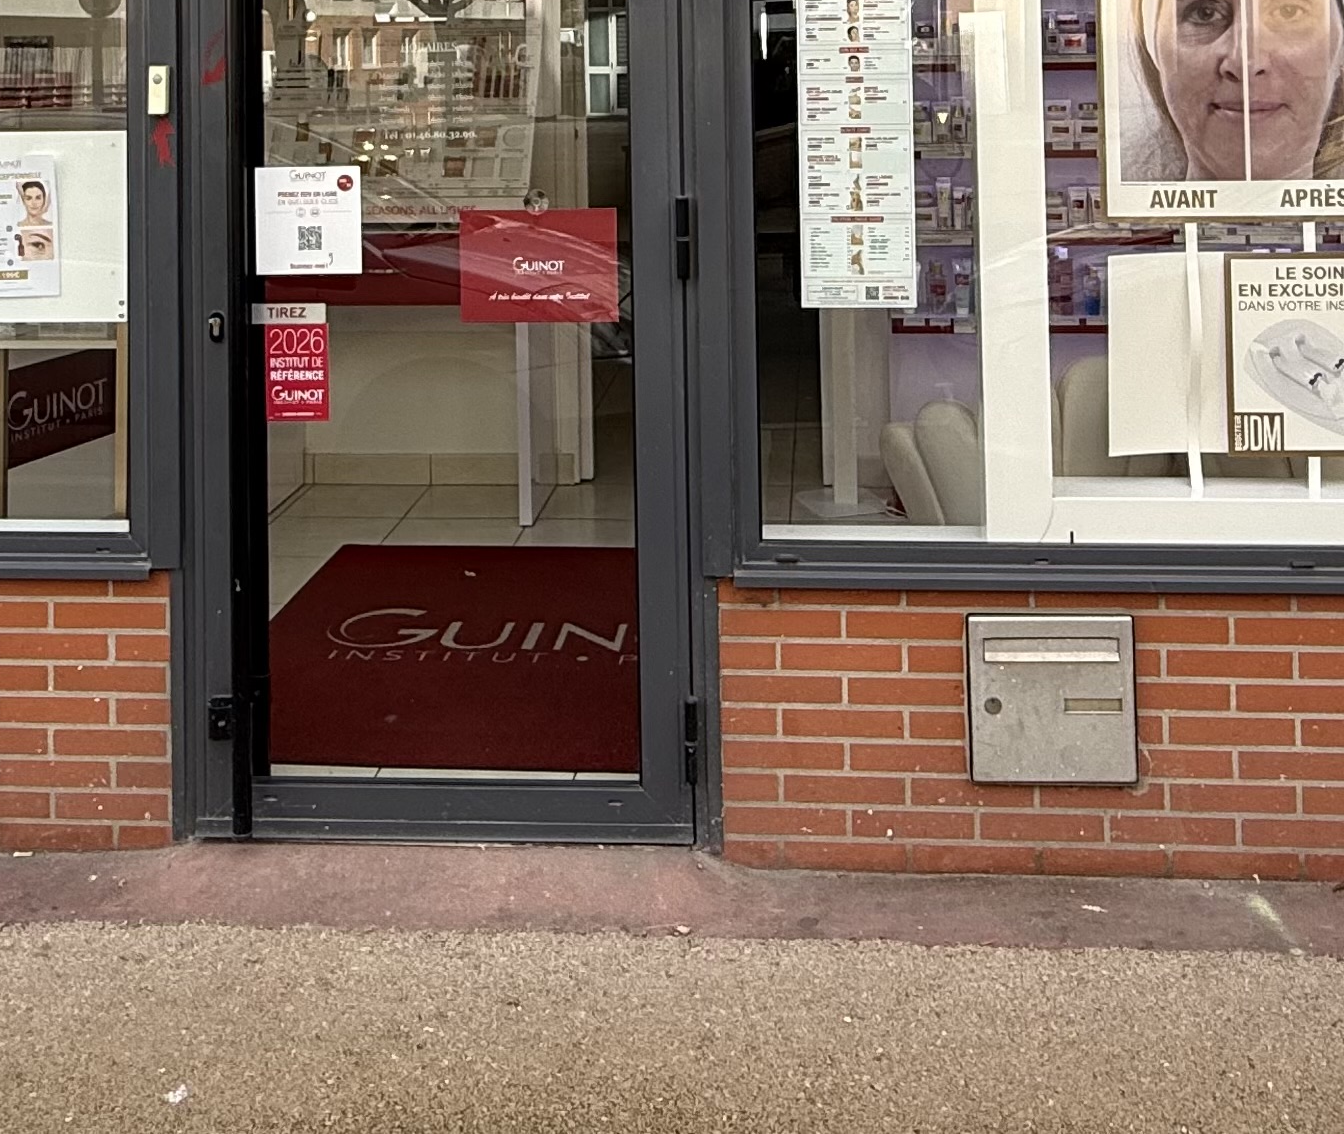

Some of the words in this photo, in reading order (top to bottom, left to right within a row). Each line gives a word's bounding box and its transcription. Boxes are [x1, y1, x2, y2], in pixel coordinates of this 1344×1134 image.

[1150, 189, 1218, 209] AVANT
[513, 256, 566, 272] GUINOT
[1275, 267, 1298, 281] LE
[1302, 266, 1344, 280] SOIN
[1238, 283, 1263, 298] EN
[267, 307, 307, 319] TIREZ
[1238, 300, 1275, 312] DANS
[1278, 300, 1321, 311] VOTRE
[269, 328, 325, 355] 2026
[269, 357, 309, 368] INSTITUT
[311, 357, 324, 368] DE
[270, 368, 325, 381] RÉFÉRENCE
[271, 385, 325, 401] GUINOT
[8, 377, 108, 431] GUINOT
[10, 418, 61, 444] INSTITUT
[1242, 414, 1282, 451] JDM
[326, 608, 629, 653] GUIN
[326, 649, 549, 664] INSTITUT
